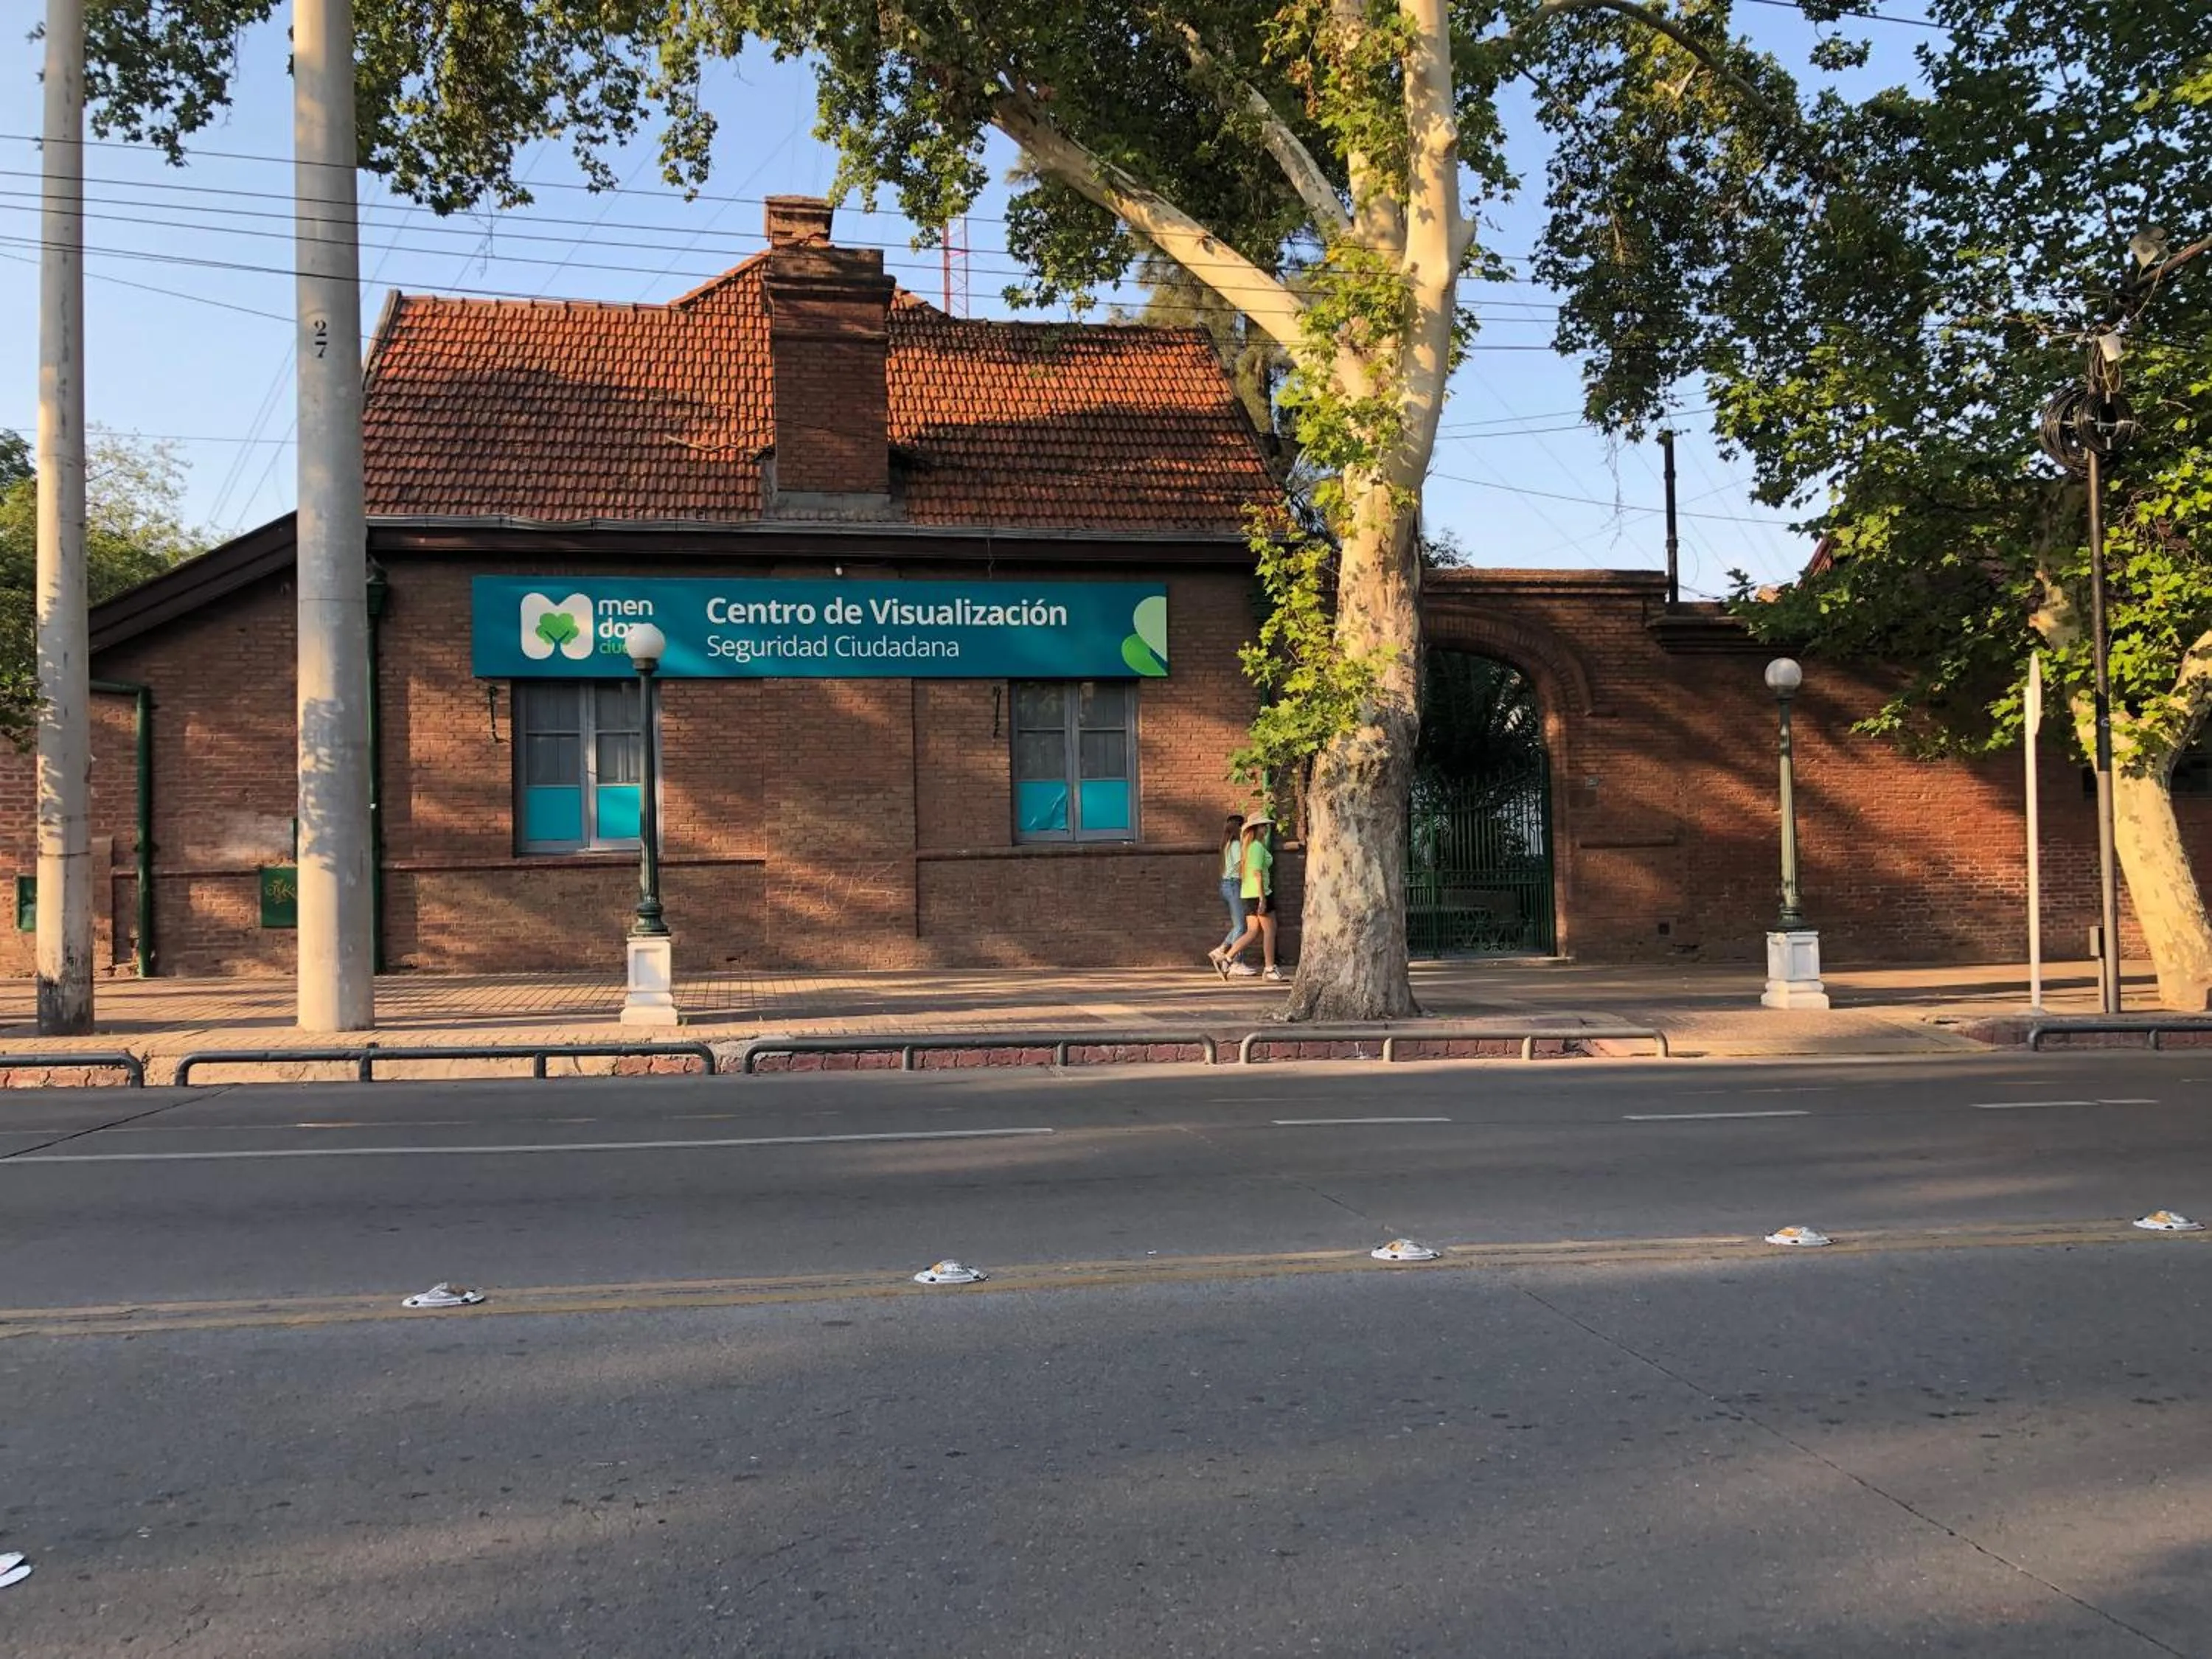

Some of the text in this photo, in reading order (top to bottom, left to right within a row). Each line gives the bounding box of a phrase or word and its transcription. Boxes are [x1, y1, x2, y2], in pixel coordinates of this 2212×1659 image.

[598, 599, 653, 616] men
[706, 597, 1067, 625] Centro de Visualización
[707, 635, 959, 663] Seguridad Ciudadana
